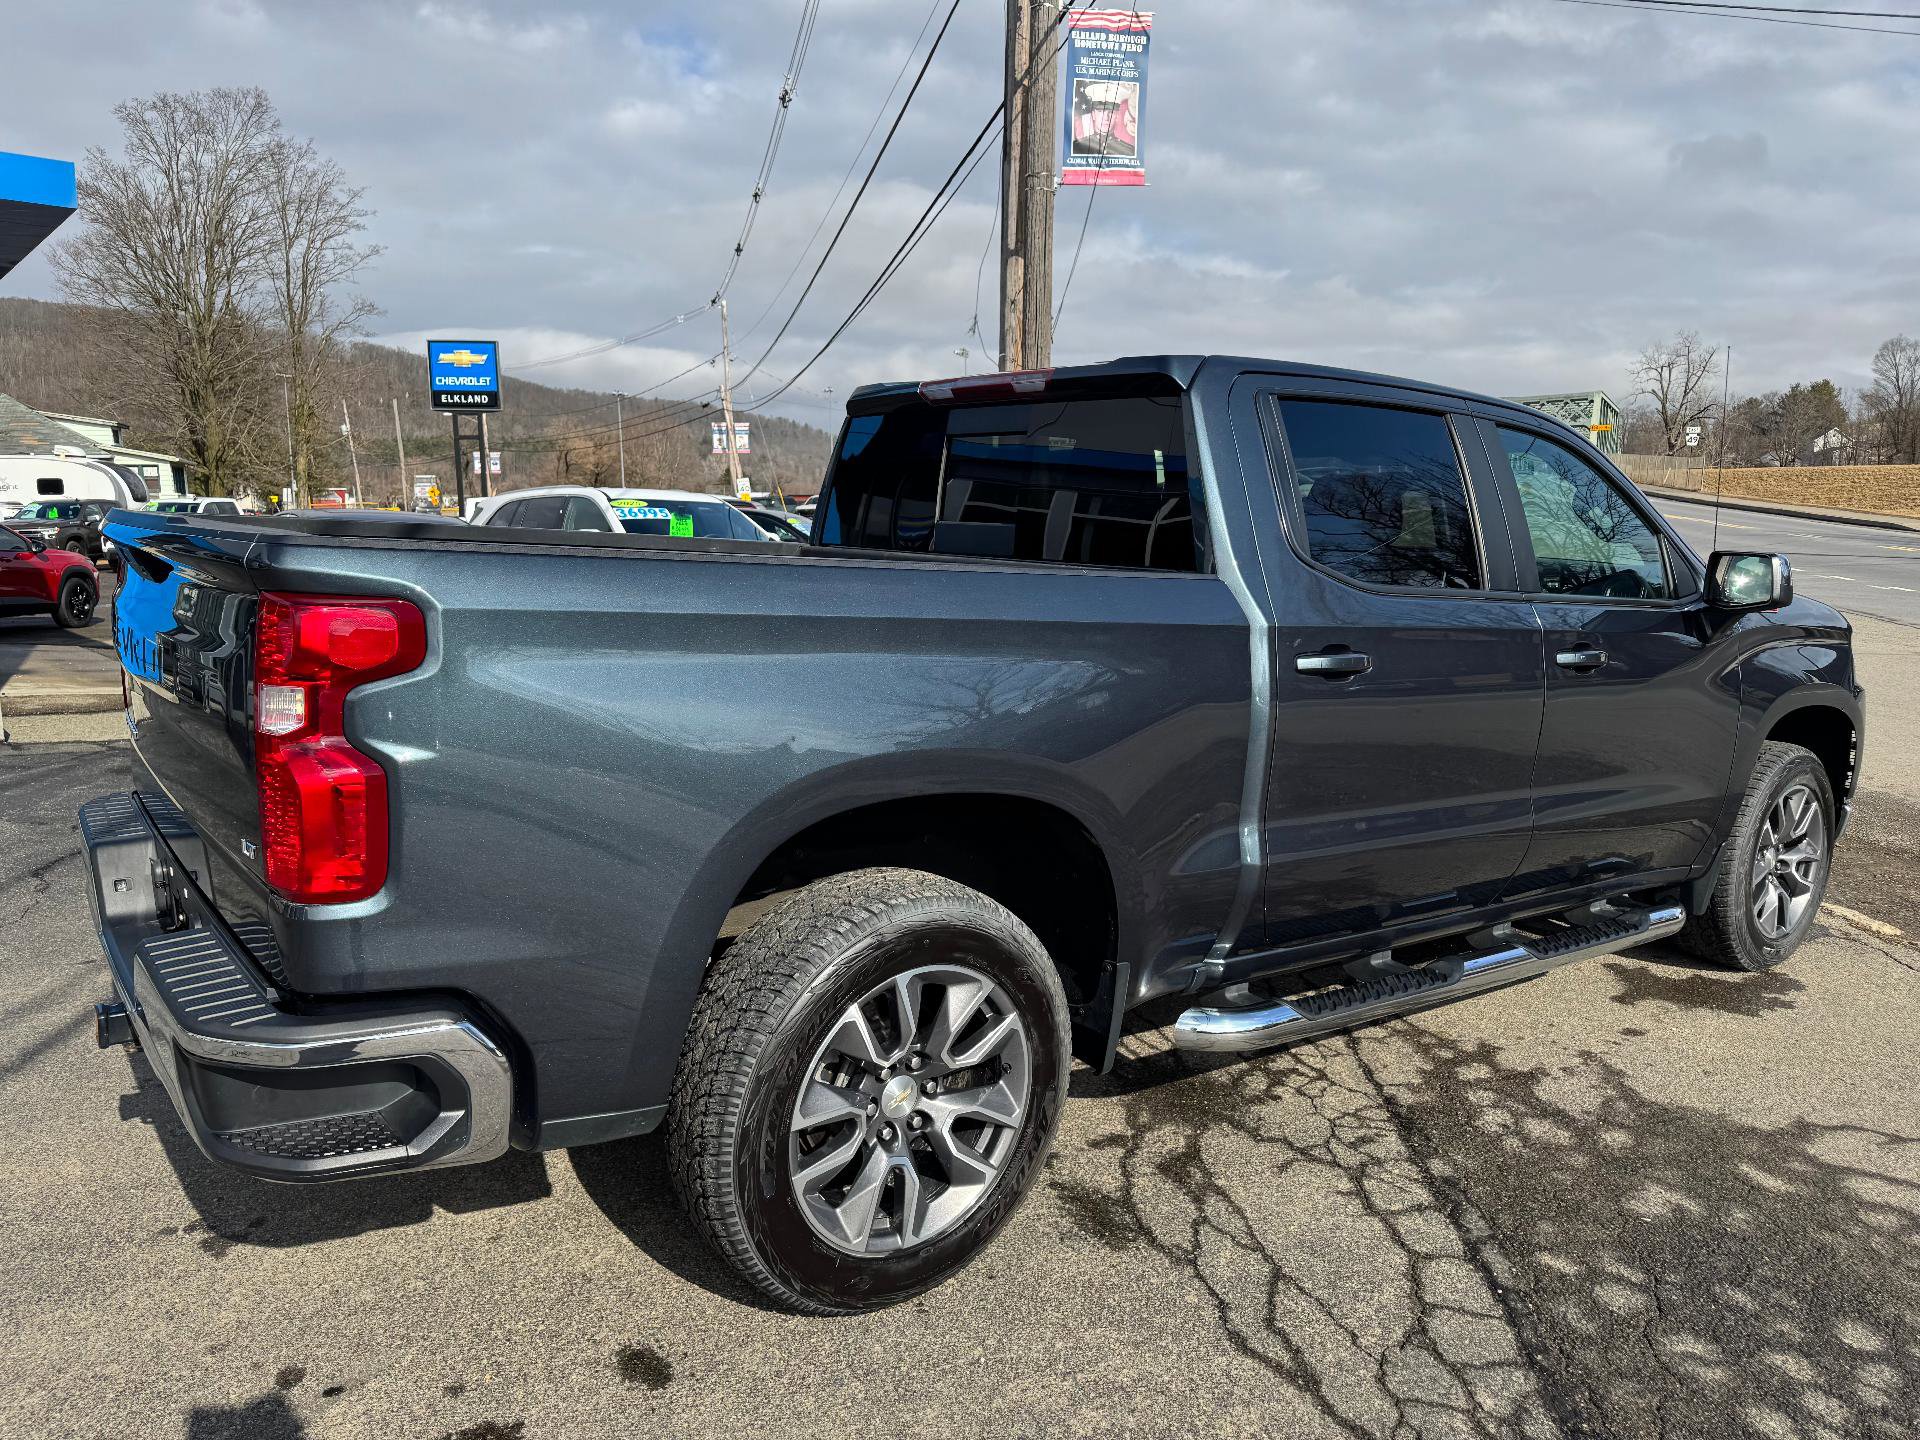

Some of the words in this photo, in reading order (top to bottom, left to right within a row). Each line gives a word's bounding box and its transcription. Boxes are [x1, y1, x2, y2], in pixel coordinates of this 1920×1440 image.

[1071, 30, 1106, 41] ELKLAND
[1108, 33, 1147, 45] BOROUGH
[1074, 40, 1119, 51] HOMETOWN
[1121, 42, 1143, 53] HERO
[1080, 56, 1111, 66] MICHAEL
[1112, 59, 1135, 68] PLANK
[1088, 67, 1117, 76] MARINE
[1117, 69, 1139, 77] CORPS
[435, 376, 491, 386] CHEVROLET
[441, 394, 489, 404] ELKLAND
[1687, 436, 1698, 444] 49
[615, 508, 669, 518] 36995
